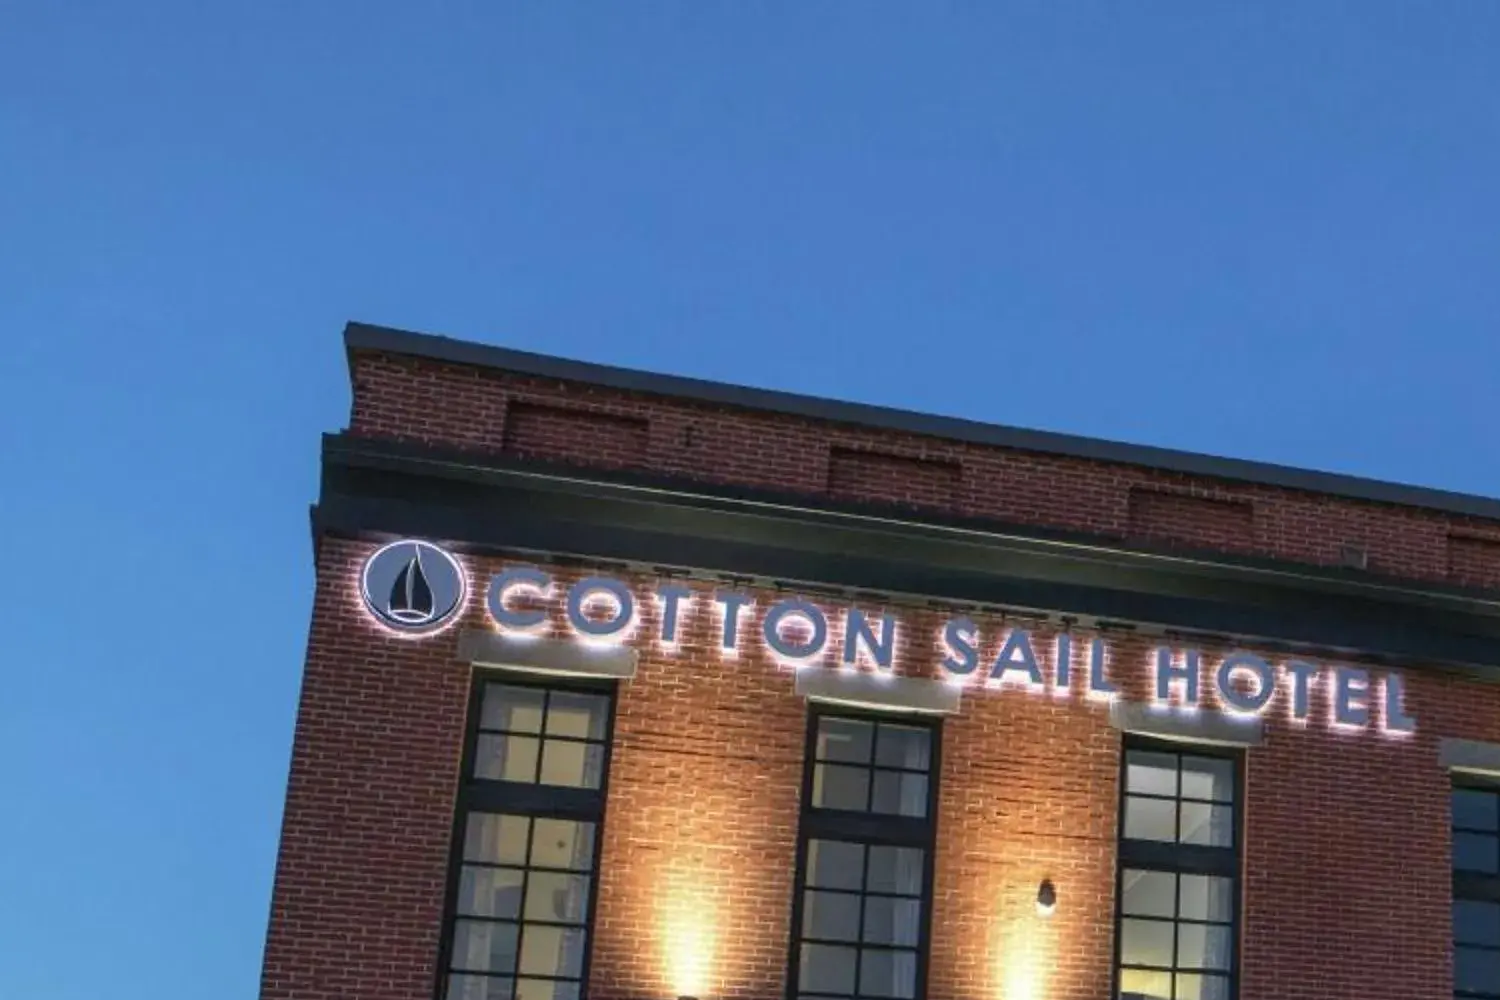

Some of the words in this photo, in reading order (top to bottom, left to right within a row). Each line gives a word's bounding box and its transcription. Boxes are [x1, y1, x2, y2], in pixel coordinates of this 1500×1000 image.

[487, 566, 894, 670] COTTON
[941, 618, 1118, 698] SAIL
[1154, 646, 1417, 733] HOTEL
